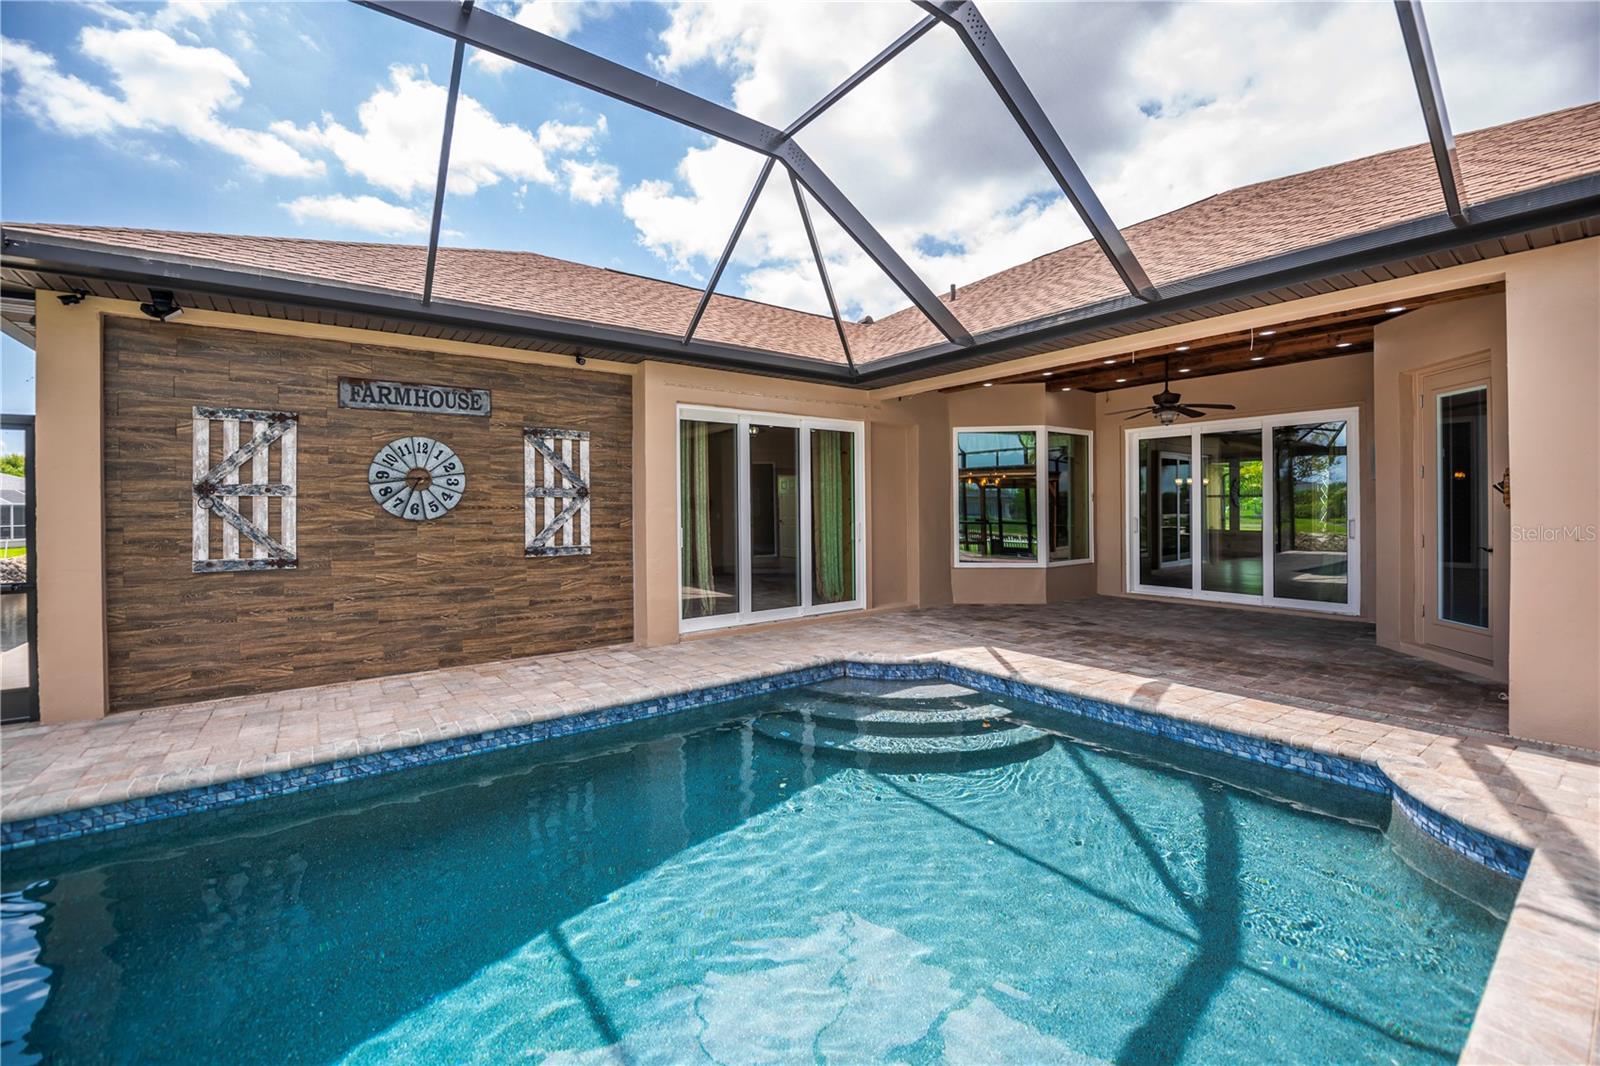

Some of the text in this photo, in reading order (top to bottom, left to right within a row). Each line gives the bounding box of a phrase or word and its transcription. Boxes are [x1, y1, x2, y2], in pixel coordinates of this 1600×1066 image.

[350, 383, 482, 410] FARMHOUSE
[398, 444, 412, 456] 11
[416, 442, 428, 454] 12
[382, 453, 398, 466] 10
[434, 450, 443, 460] 1
[443, 462, 456, 472] 2
[375, 470, 389, 479] 9
[446, 478, 459, 486] 3
[379, 486, 392, 496] 8
[393, 497, 404, 508] 7
[441, 492, 454, 502] 4
[410, 503, 419, 515] 6
[428, 501, 439, 512] 5
